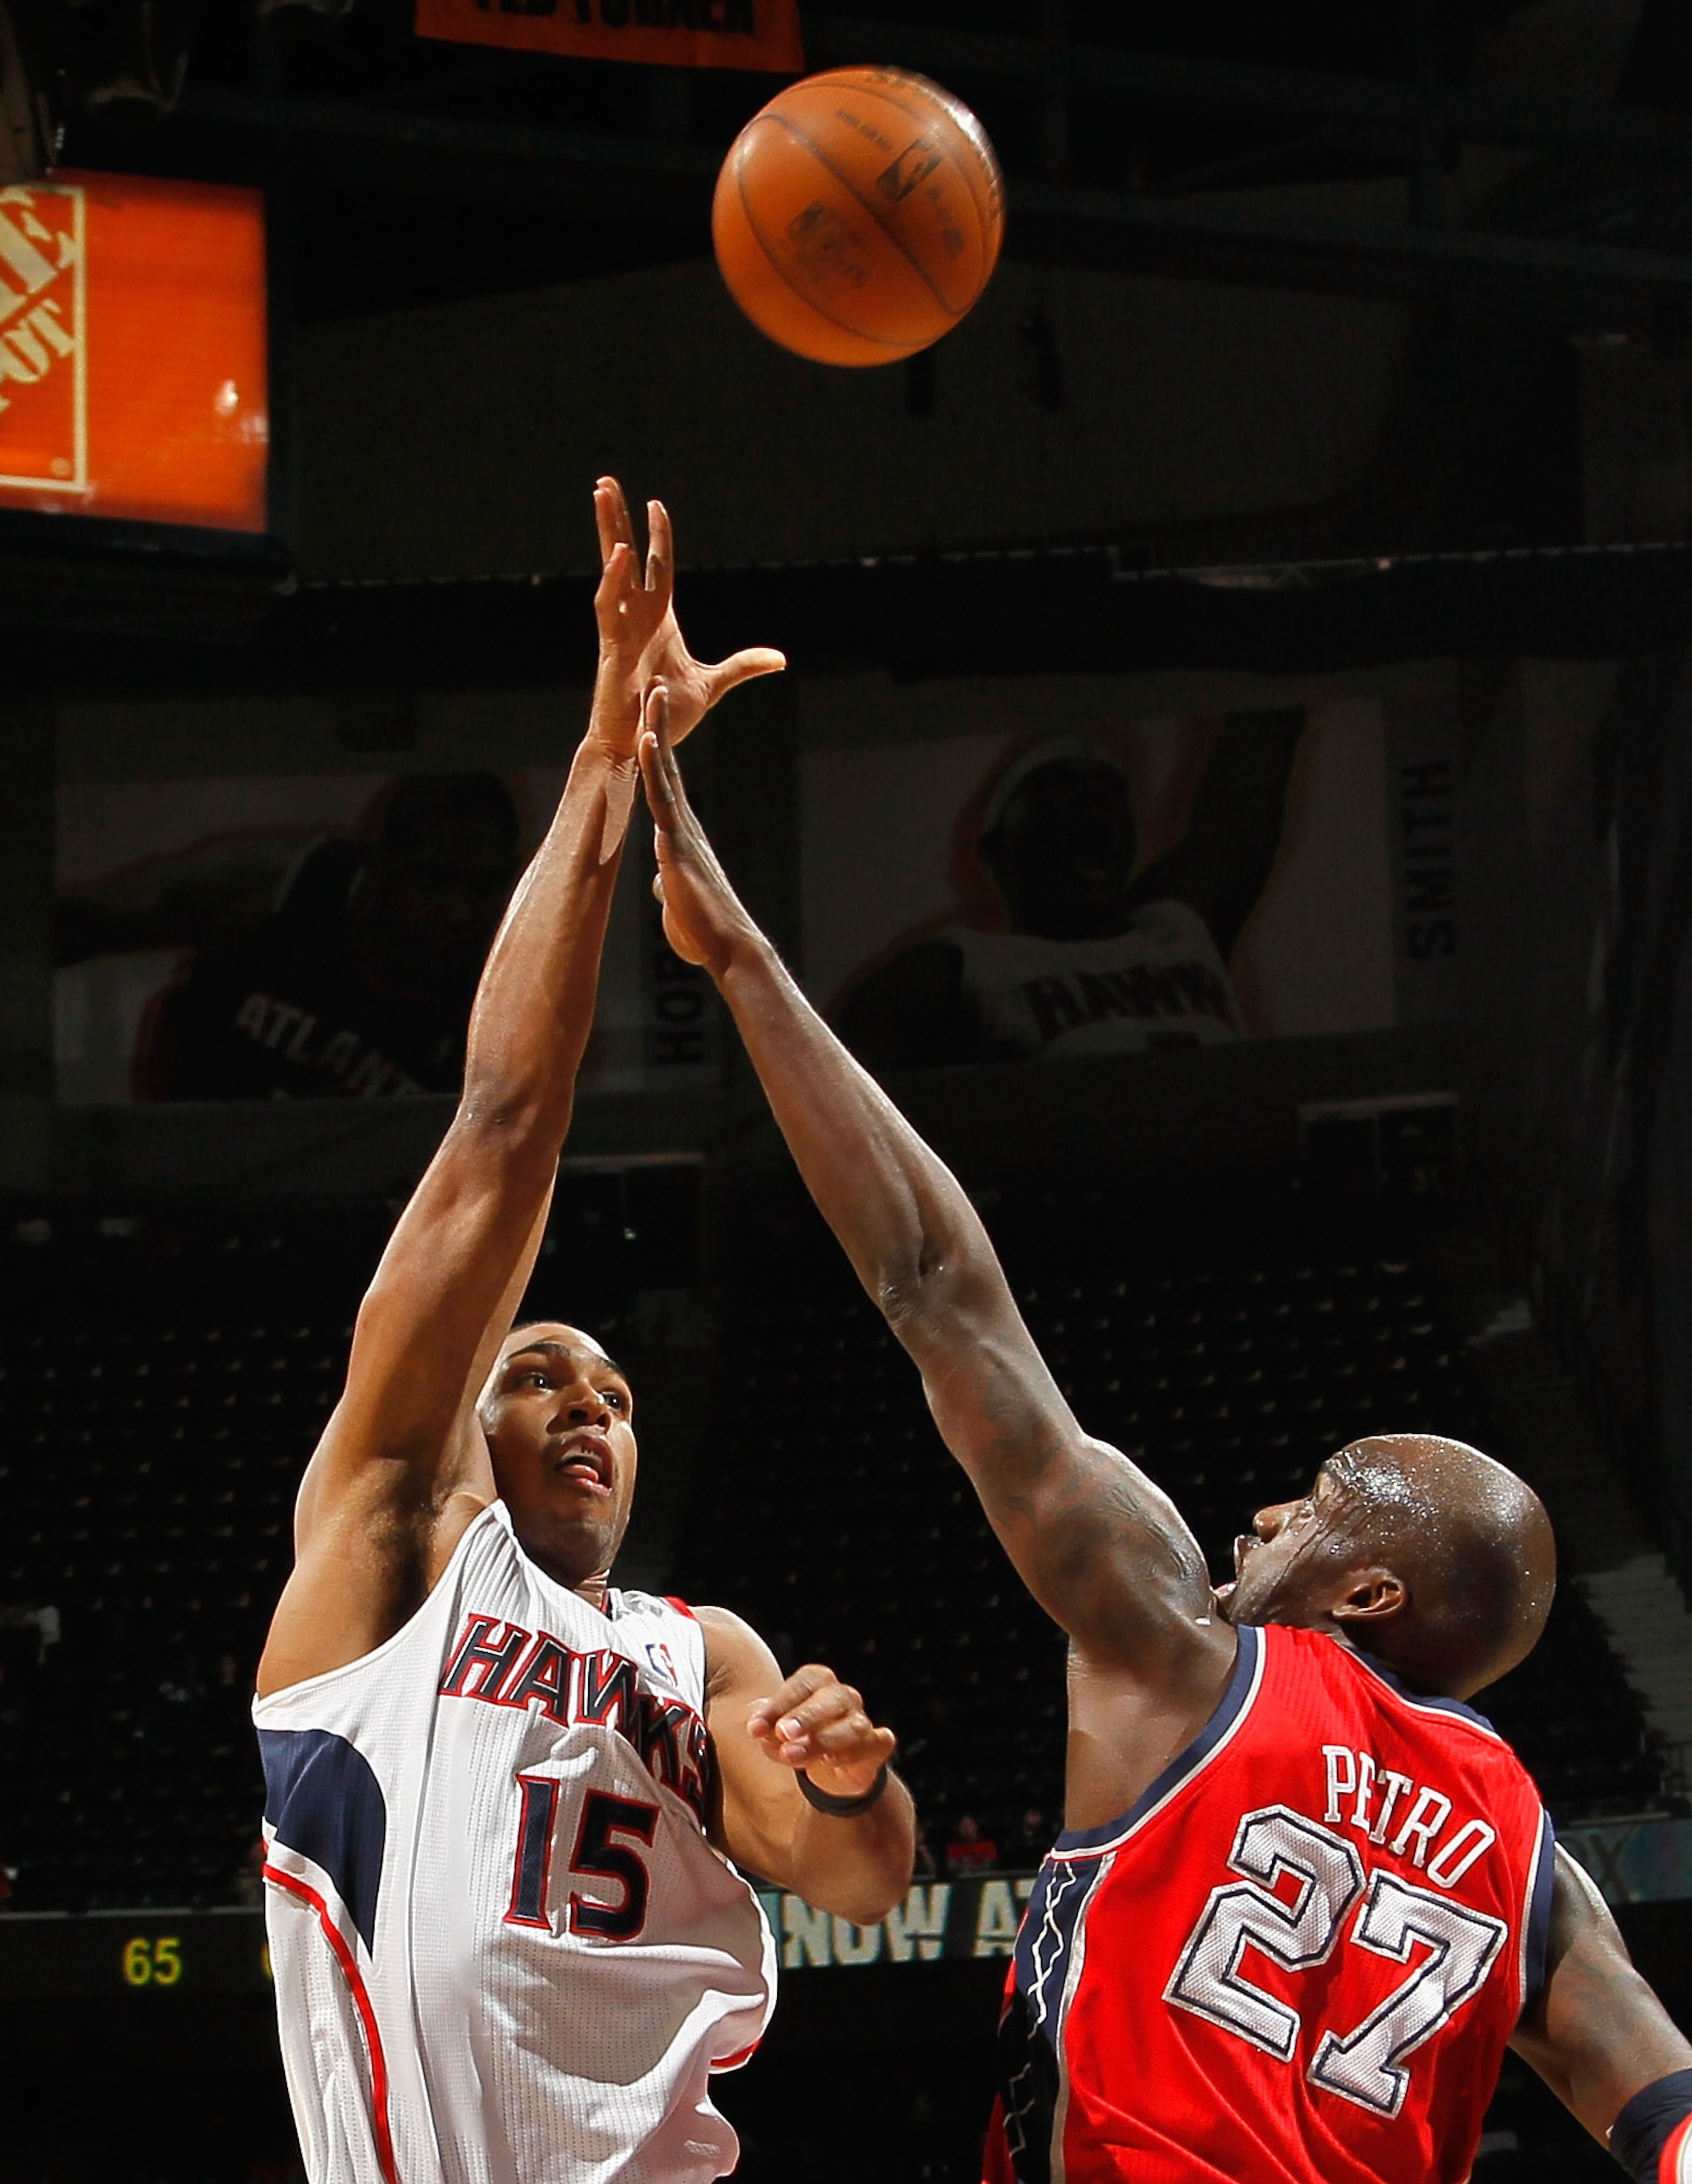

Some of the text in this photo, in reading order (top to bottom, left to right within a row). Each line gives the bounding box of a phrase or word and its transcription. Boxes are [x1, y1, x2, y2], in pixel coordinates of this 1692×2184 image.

[1402, 761, 1456, 958] SMITH
[503, 1773, 662, 1943] 15
[1322, 1745, 1496, 1889] PETRO
[123, 1936, 184, 1986] 65
[1161, 1804, 1509, 2121] 27
